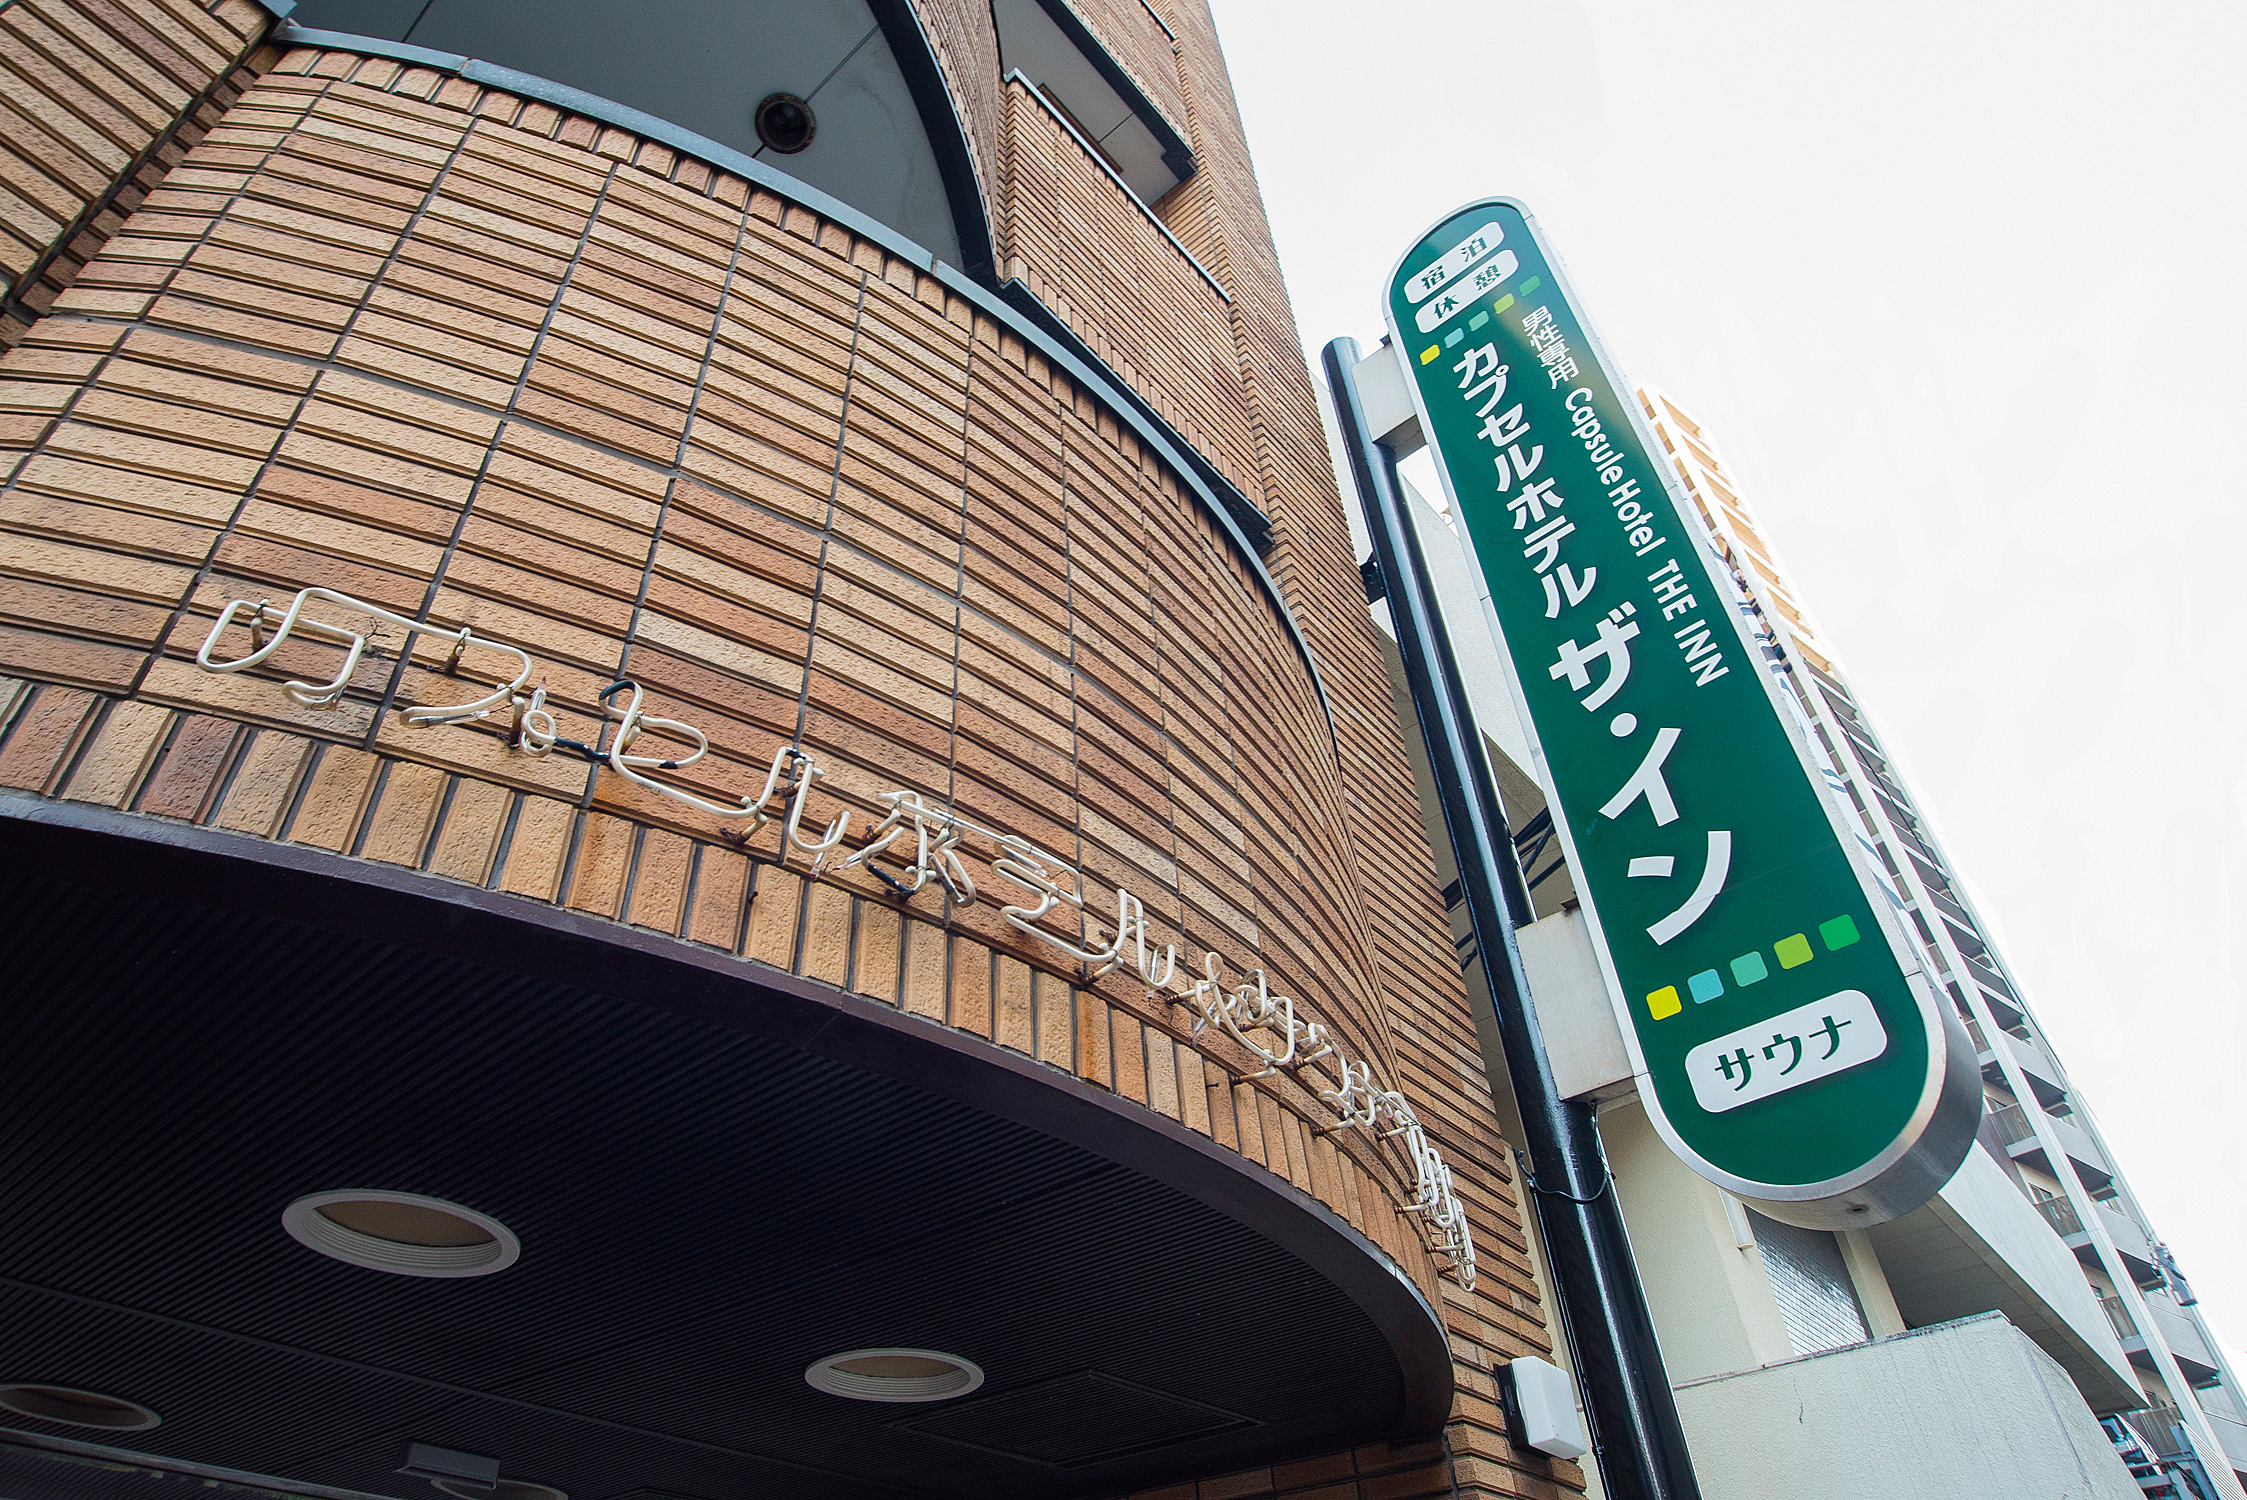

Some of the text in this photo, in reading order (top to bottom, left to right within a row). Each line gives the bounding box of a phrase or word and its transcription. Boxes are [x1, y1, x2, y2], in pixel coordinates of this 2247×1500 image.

[1421, 237, 1488, 290] 宿泊
[1434, 264, 1502, 320] 休憩
[1521, 305, 1580, 390] 男性専用
[1565, 387, 1730, 687] Capsule Hotel THE INN
[1452, 342, 1732, 946] カプセルホテル ザ・イン
[1714, 1015, 1852, 1092] サウナ
